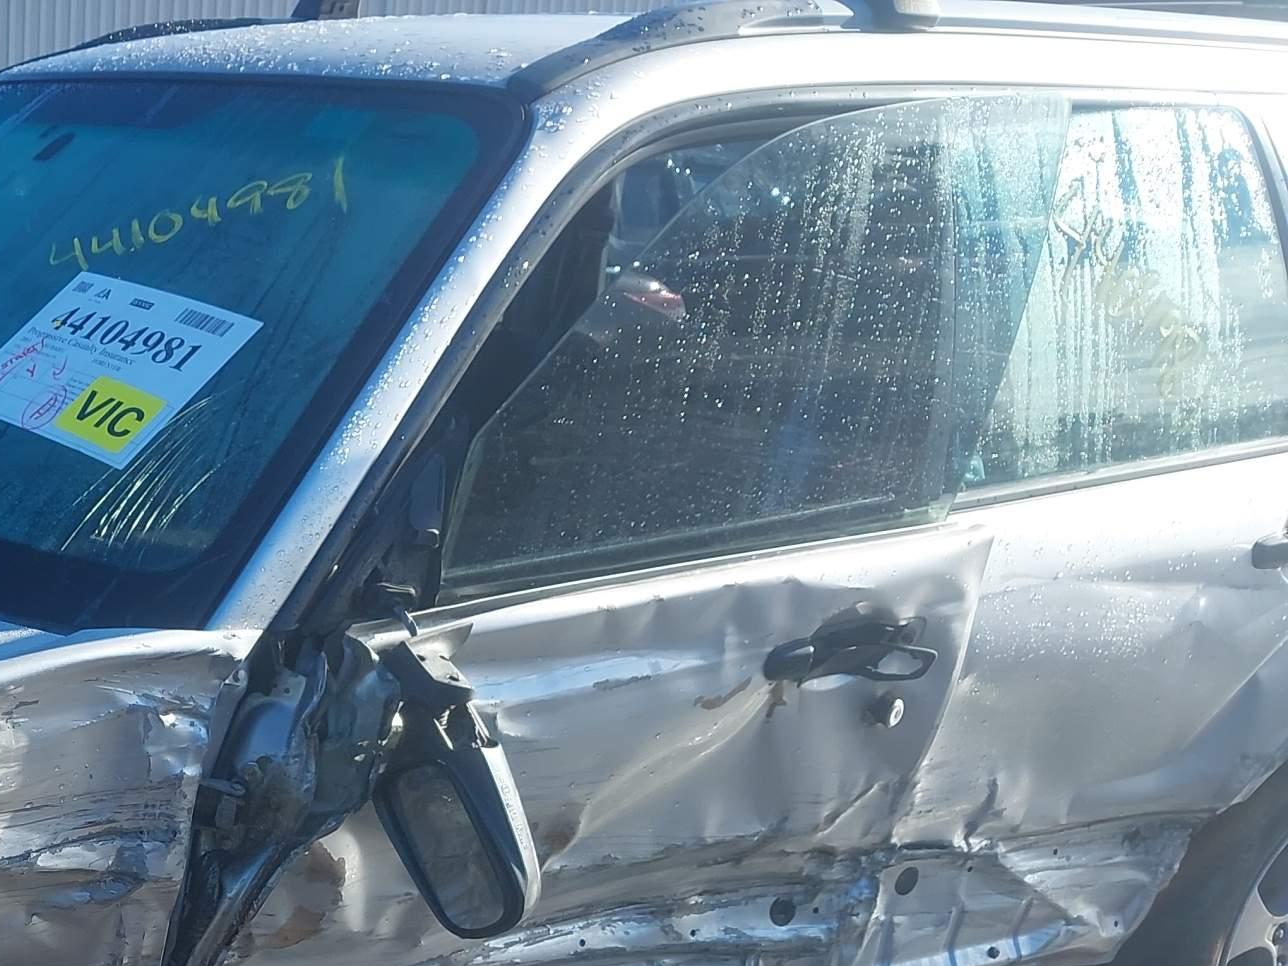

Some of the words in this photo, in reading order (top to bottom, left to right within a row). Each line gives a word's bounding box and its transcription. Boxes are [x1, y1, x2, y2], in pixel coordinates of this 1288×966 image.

[49, 154, 349, 271] 44104981
[51, 306, 203, 373] 44104981
[75, 390, 145, 437] VIC
